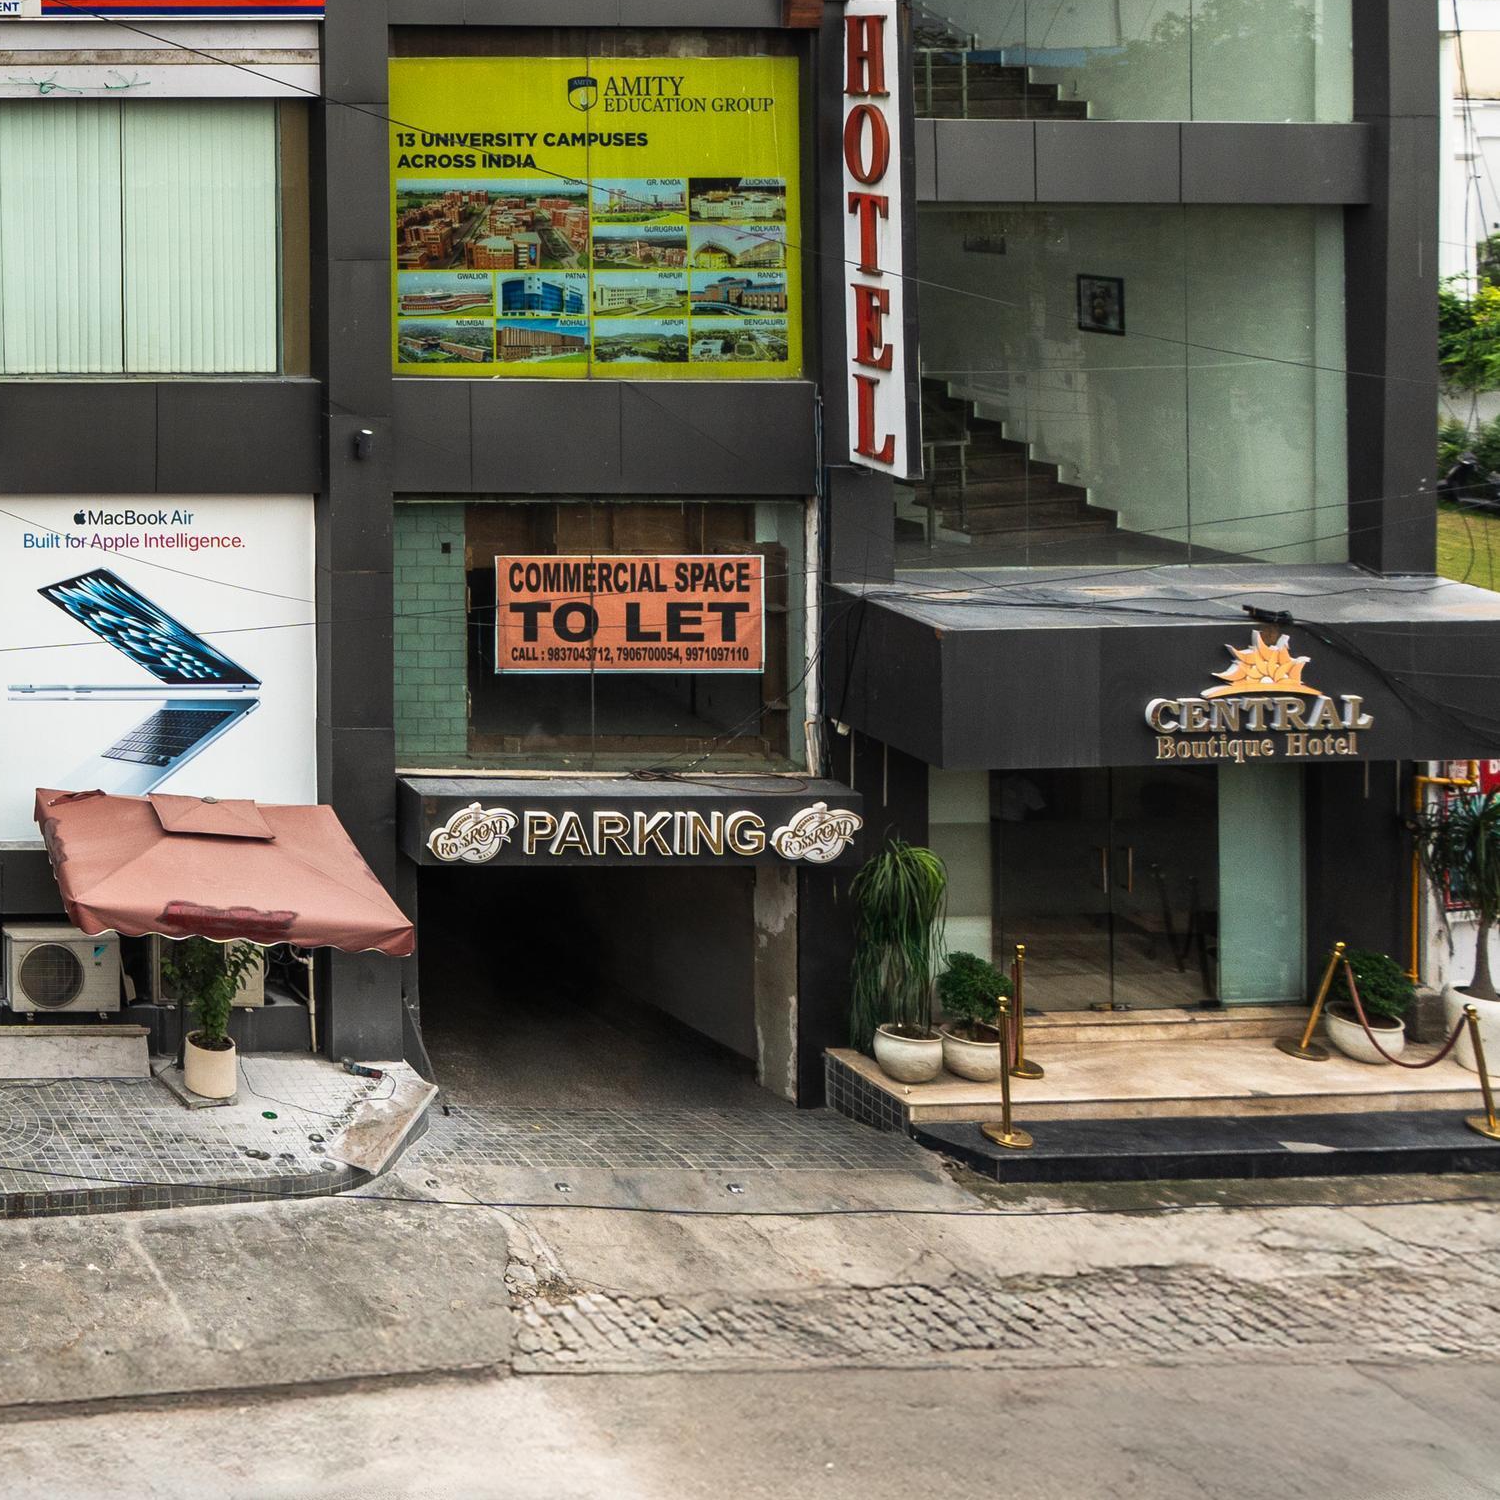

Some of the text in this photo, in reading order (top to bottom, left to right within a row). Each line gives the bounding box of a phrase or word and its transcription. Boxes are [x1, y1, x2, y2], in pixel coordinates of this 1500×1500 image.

[604, 76, 685, 96] AMITY
[604, 97, 774, 112] EDUCATION GROUP
[397, 132, 648, 147] 13 UNIVERSITY CAMPUSES
[397, 154, 537, 169] ACROSS INDIA
[843, 15, 896, 466] HOTEL
[88, 510, 194, 525] MacBook Air
[23, 533, 246, 552] Built for Apple Intelligence.
[509, 562, 750, 593] COMMERCIAL SPACE
[509, 602, 750, 642] TO LET
[511, 647, 538, 661] CALL
[547, 647, 614, 663] 9837043712,
[616, 647, 682, 663] 7906700054,
[685, 647, 748, 661] 9971097110
[1145, 695, 1374, 734] CENTRAL
[1155, 732, 1358, 763] Boutique Hotel
[523, 811, 766, 856] PARKING
